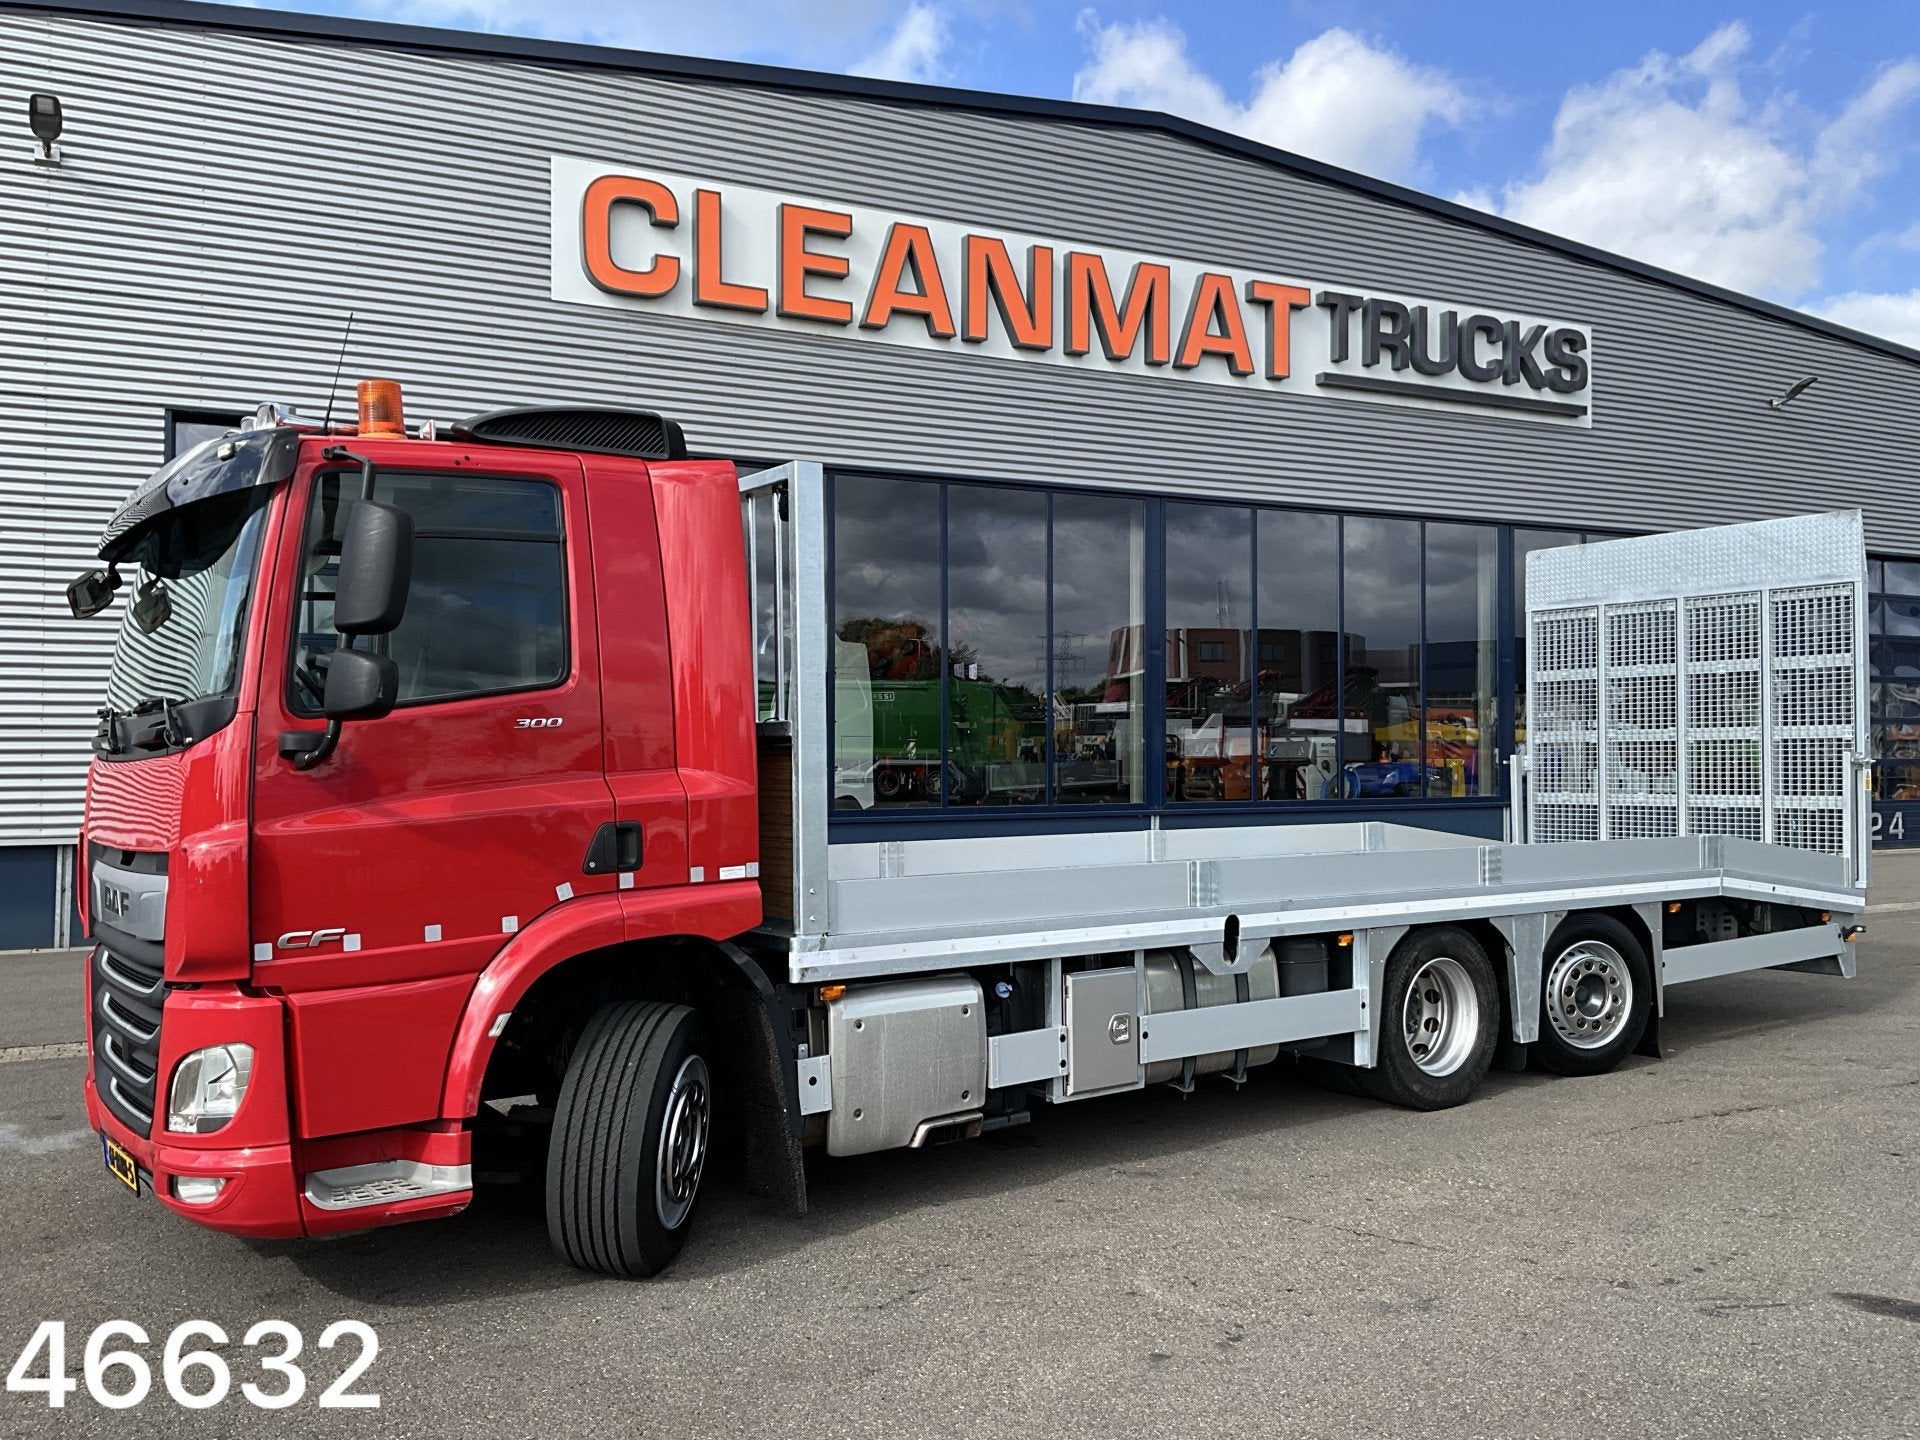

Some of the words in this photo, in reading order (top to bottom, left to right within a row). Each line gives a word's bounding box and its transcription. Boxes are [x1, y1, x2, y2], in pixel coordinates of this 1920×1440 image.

[581, 173, 1311, 381] CLEANMAT
[1316, 291, 1588, 393] TRUCKS
[513, 717, 563, 728] 300
[1871, 811, 1905, 841] 24
[104, 885, 130, 917] DAF
[277, 927, 346, 949] CF
